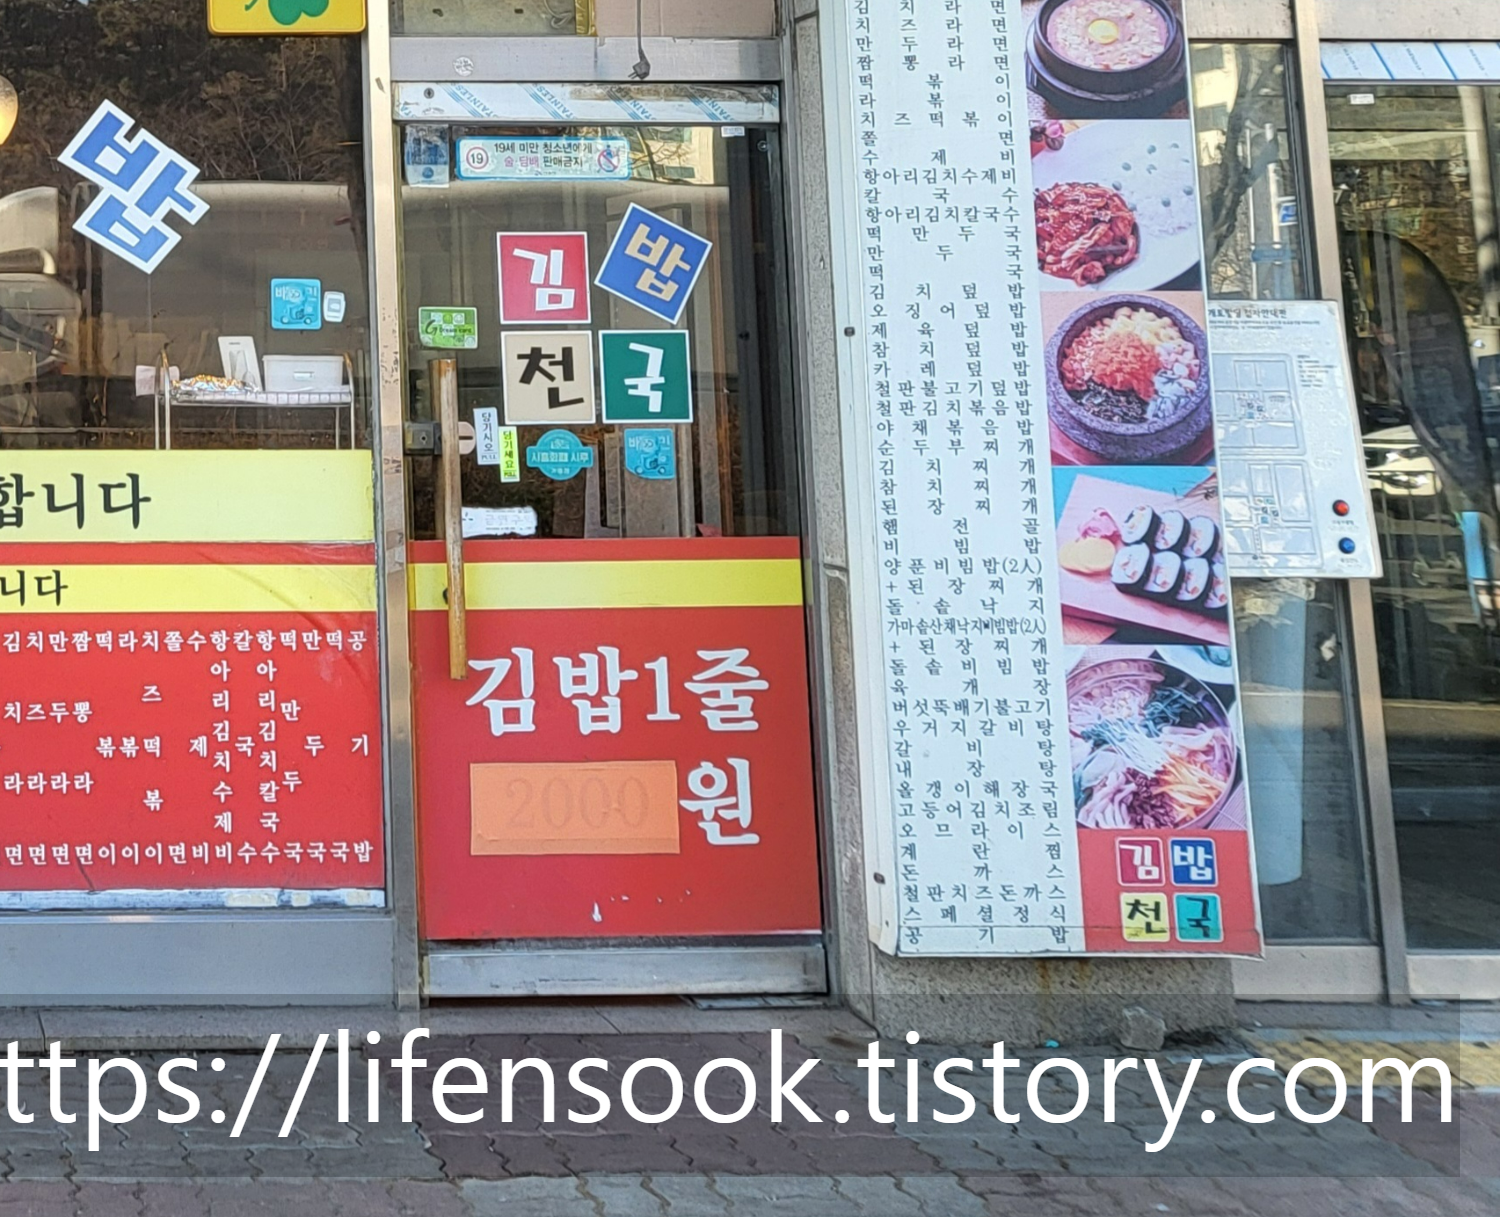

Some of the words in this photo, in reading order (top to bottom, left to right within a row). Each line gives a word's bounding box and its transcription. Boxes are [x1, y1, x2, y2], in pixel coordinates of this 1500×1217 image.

[471, 153, 483, 164] 19
[519, 142, 539, 154] 미만
[543, 156, 583, 168] 판매금지
[482, 412, 494, 452] 당기시오
[465, 646, 770, 737] 김밥1줄
[679, 757, 761, 846] 원
[1117, 843, 1214, 880] 김밥
[1126, 896, 1210, 939] 천국
